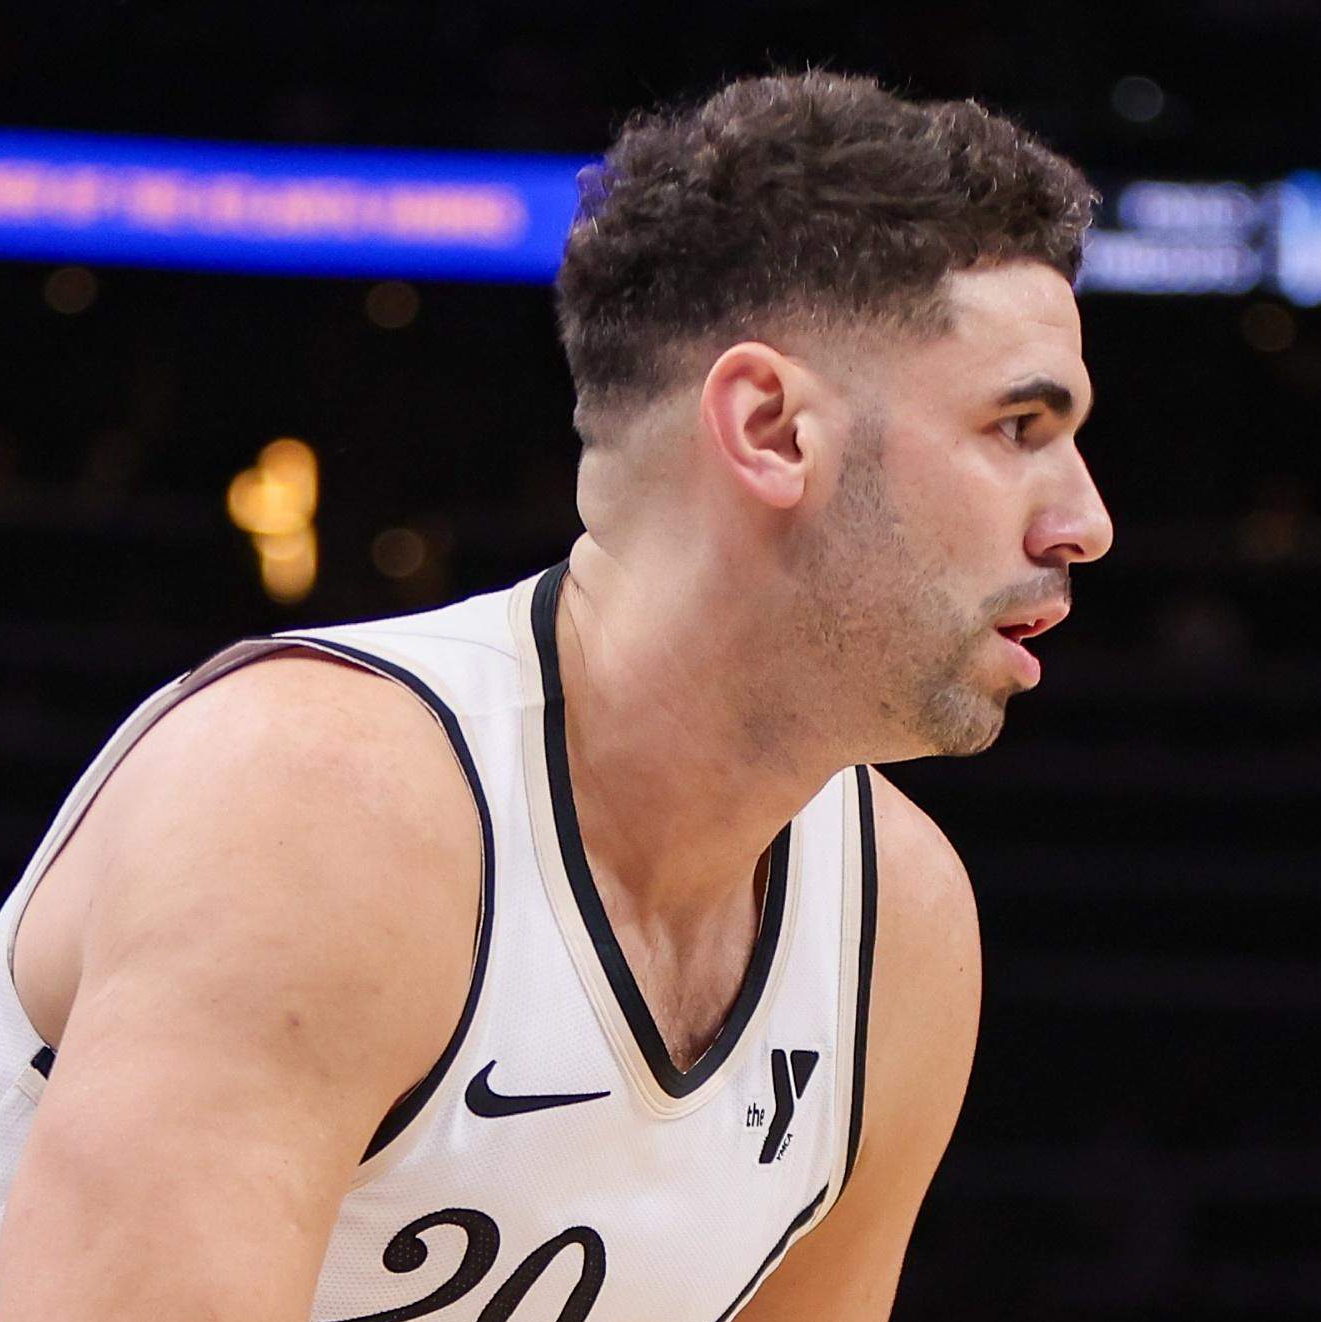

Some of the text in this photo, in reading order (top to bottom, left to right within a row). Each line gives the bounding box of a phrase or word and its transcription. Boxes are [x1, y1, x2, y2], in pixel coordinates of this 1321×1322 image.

[746, 1049, 819, 1164] the Y
[777, 1133, 794, 1161] YMCA
